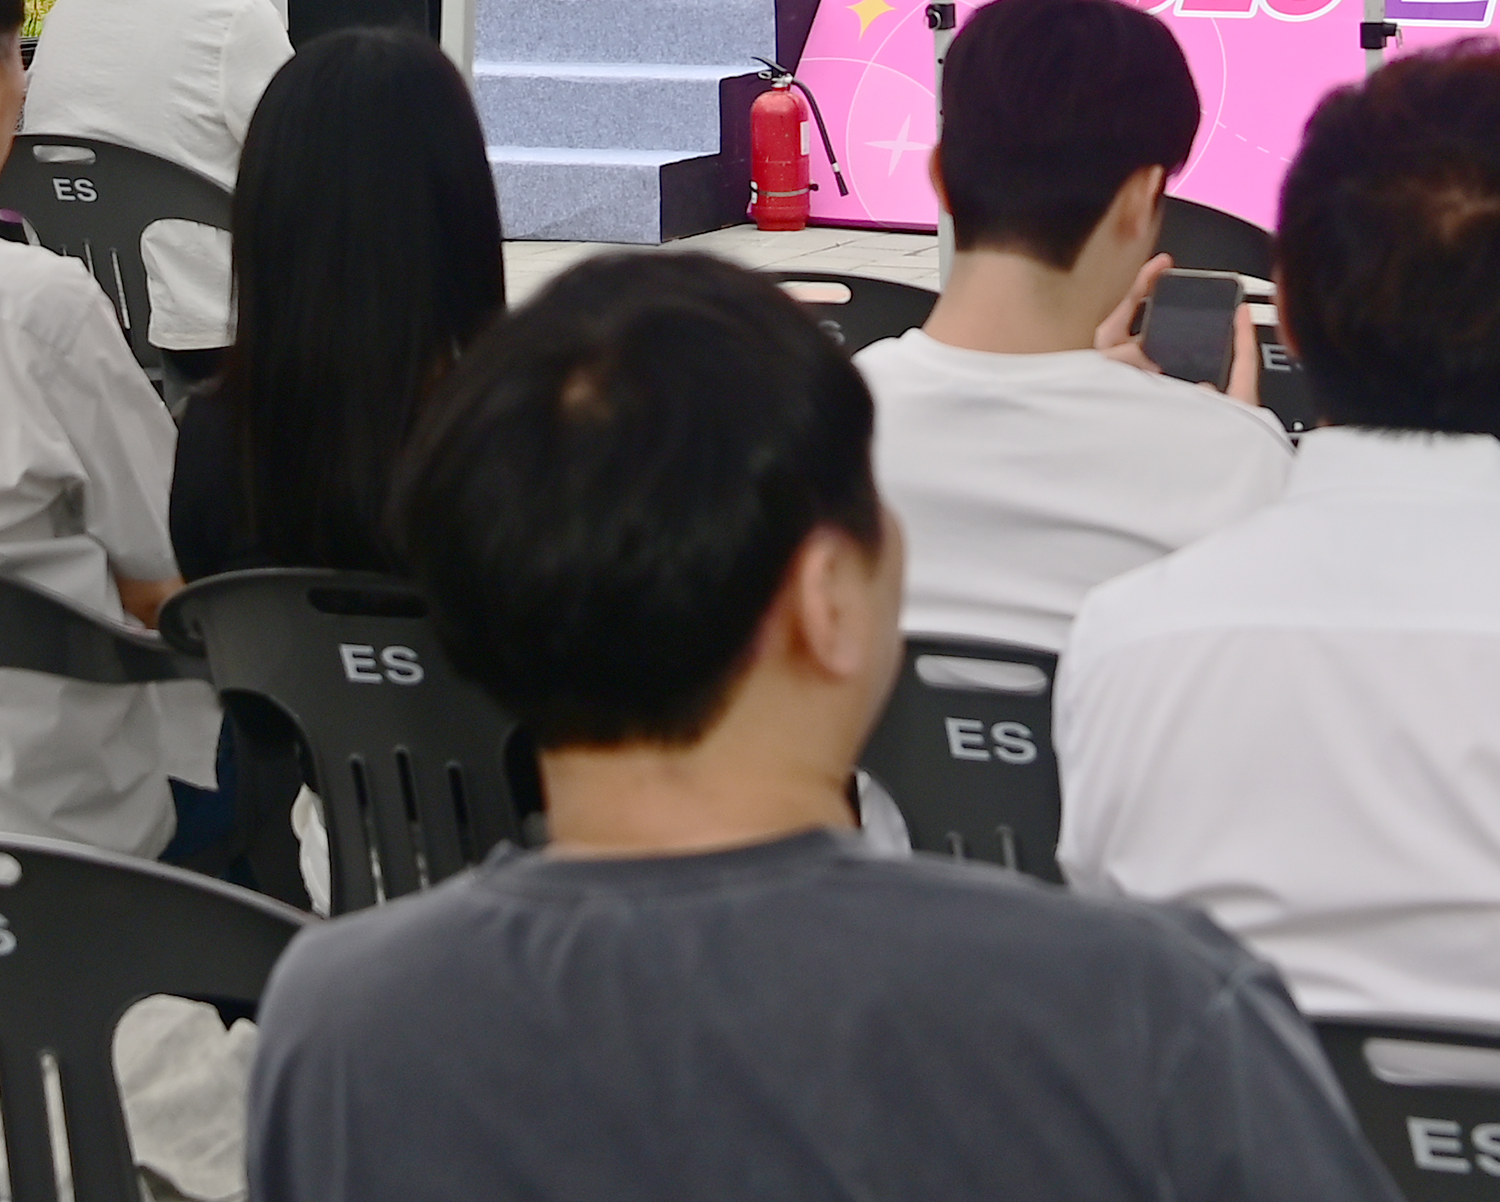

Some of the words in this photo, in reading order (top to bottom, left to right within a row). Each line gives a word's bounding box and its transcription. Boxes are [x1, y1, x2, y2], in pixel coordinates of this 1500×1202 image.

[52, 178, 97, 202] ES
[339, 643, 424, 685] ES
[945, 717, 1037, 764] ES
